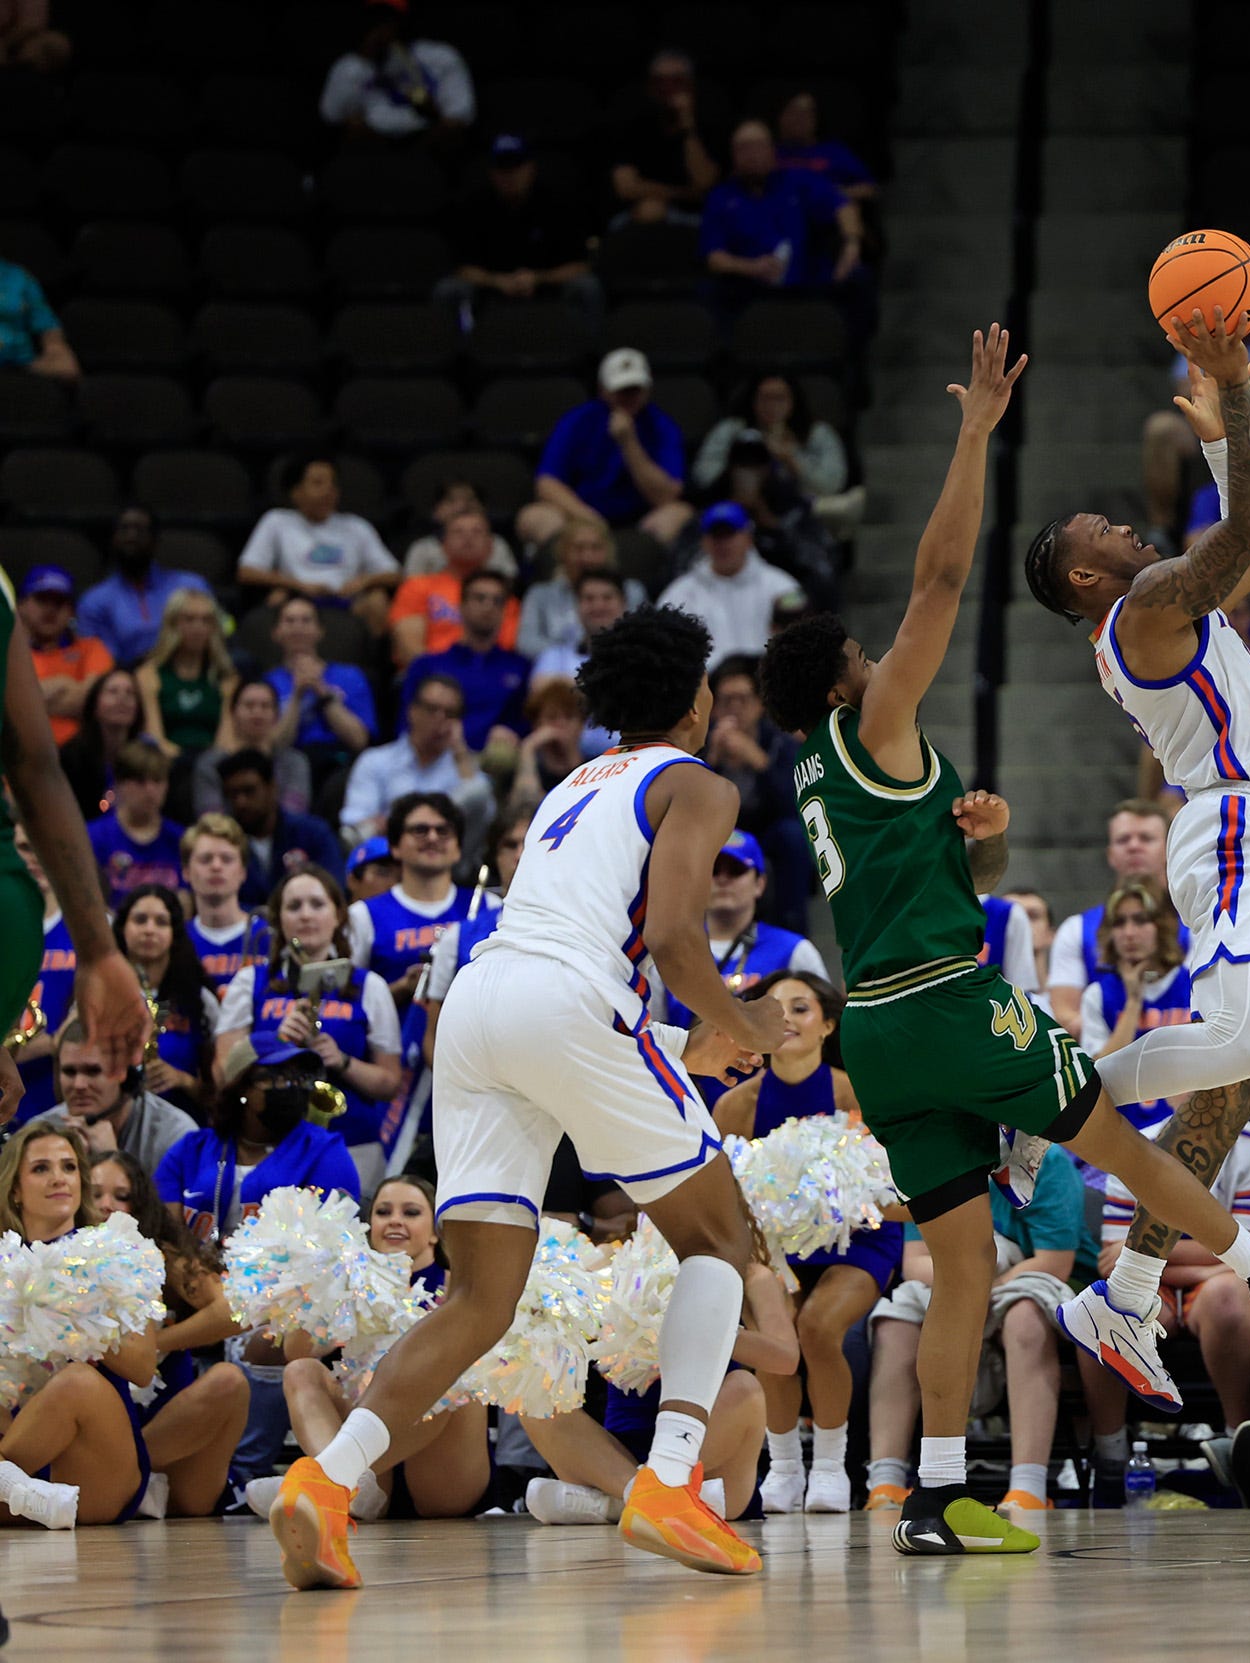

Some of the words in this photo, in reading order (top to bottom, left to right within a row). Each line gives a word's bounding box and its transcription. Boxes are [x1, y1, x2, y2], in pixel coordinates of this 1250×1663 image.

[567, 756, 639, 788] ALEXIS
[793, 752, 825, 801] LIAMS
[538, 788, 601, 853] 4
